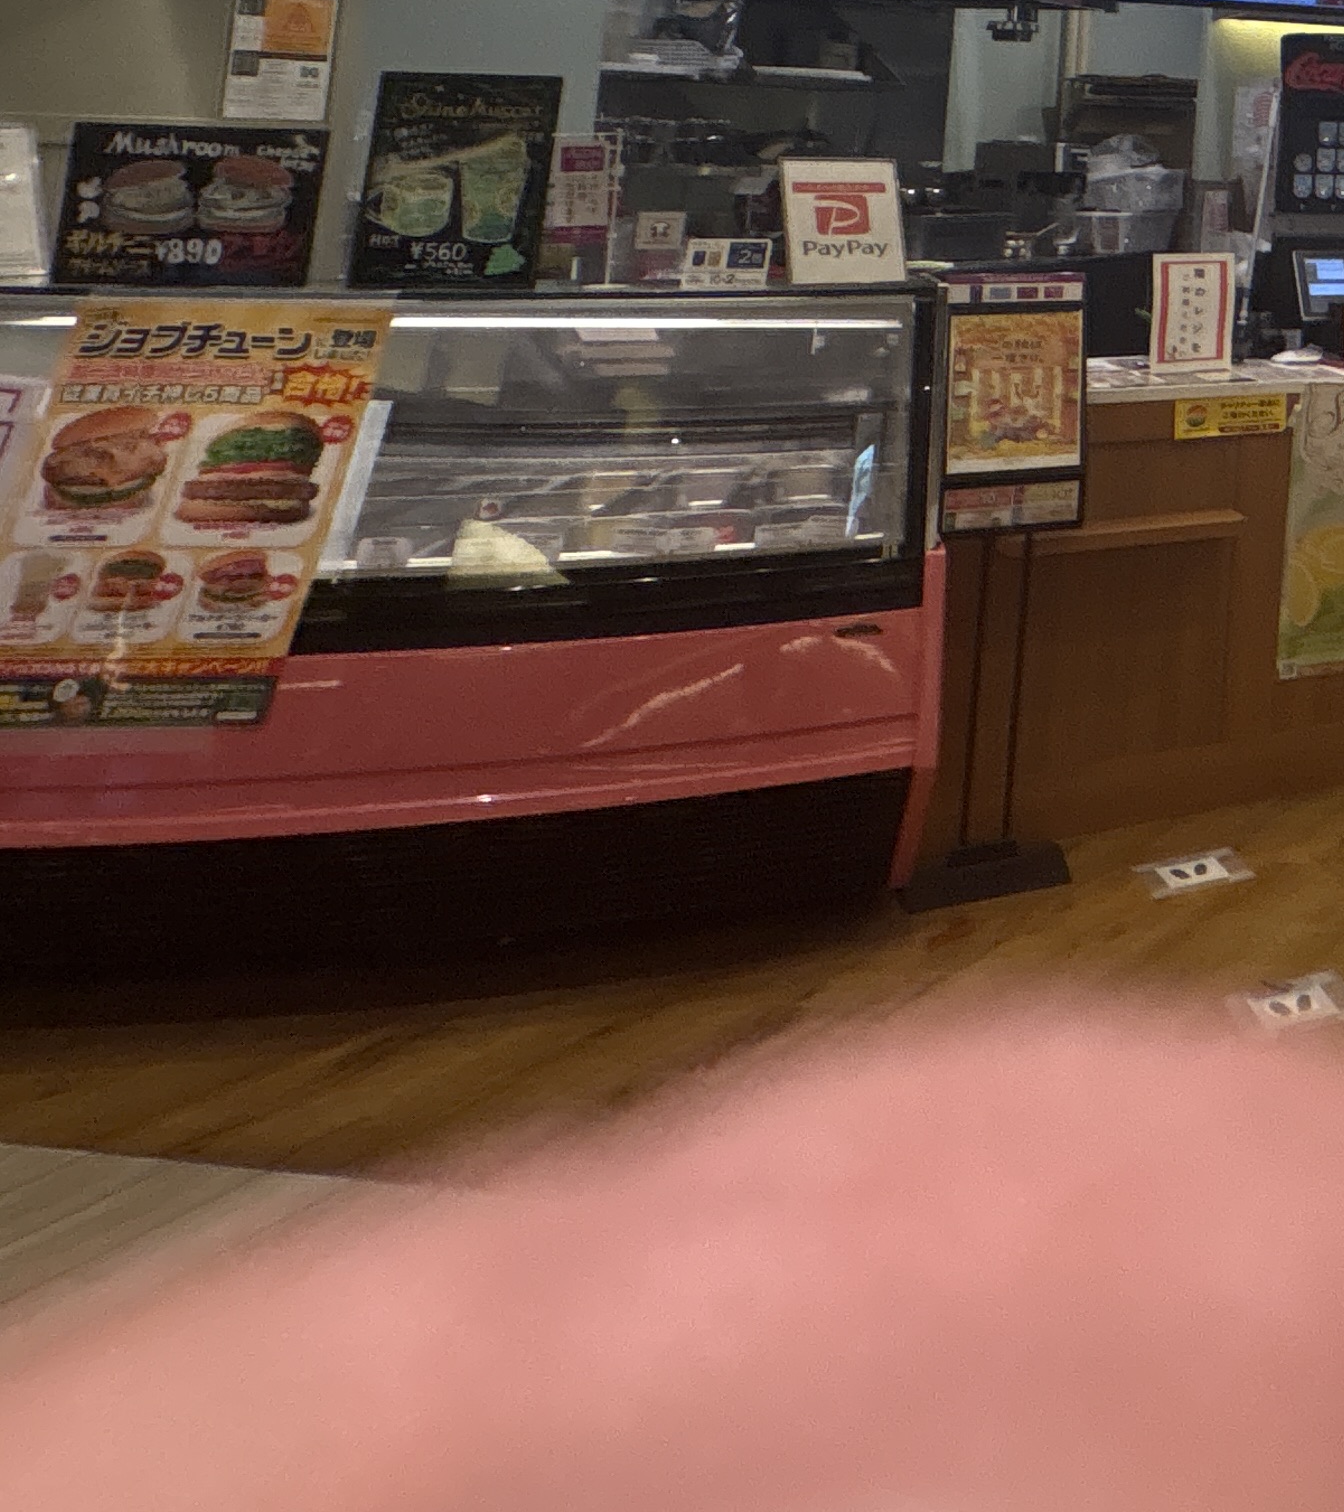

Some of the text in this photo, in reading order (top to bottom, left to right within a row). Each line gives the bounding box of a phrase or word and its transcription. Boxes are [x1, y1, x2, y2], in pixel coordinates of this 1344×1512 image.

[104, 130, 240, 158] Mushroom
[410, 242, 467, 261] ¥560
[802, 240, 888, 258] PayPay
[77, 321, 314, 361] ジョブチューン
